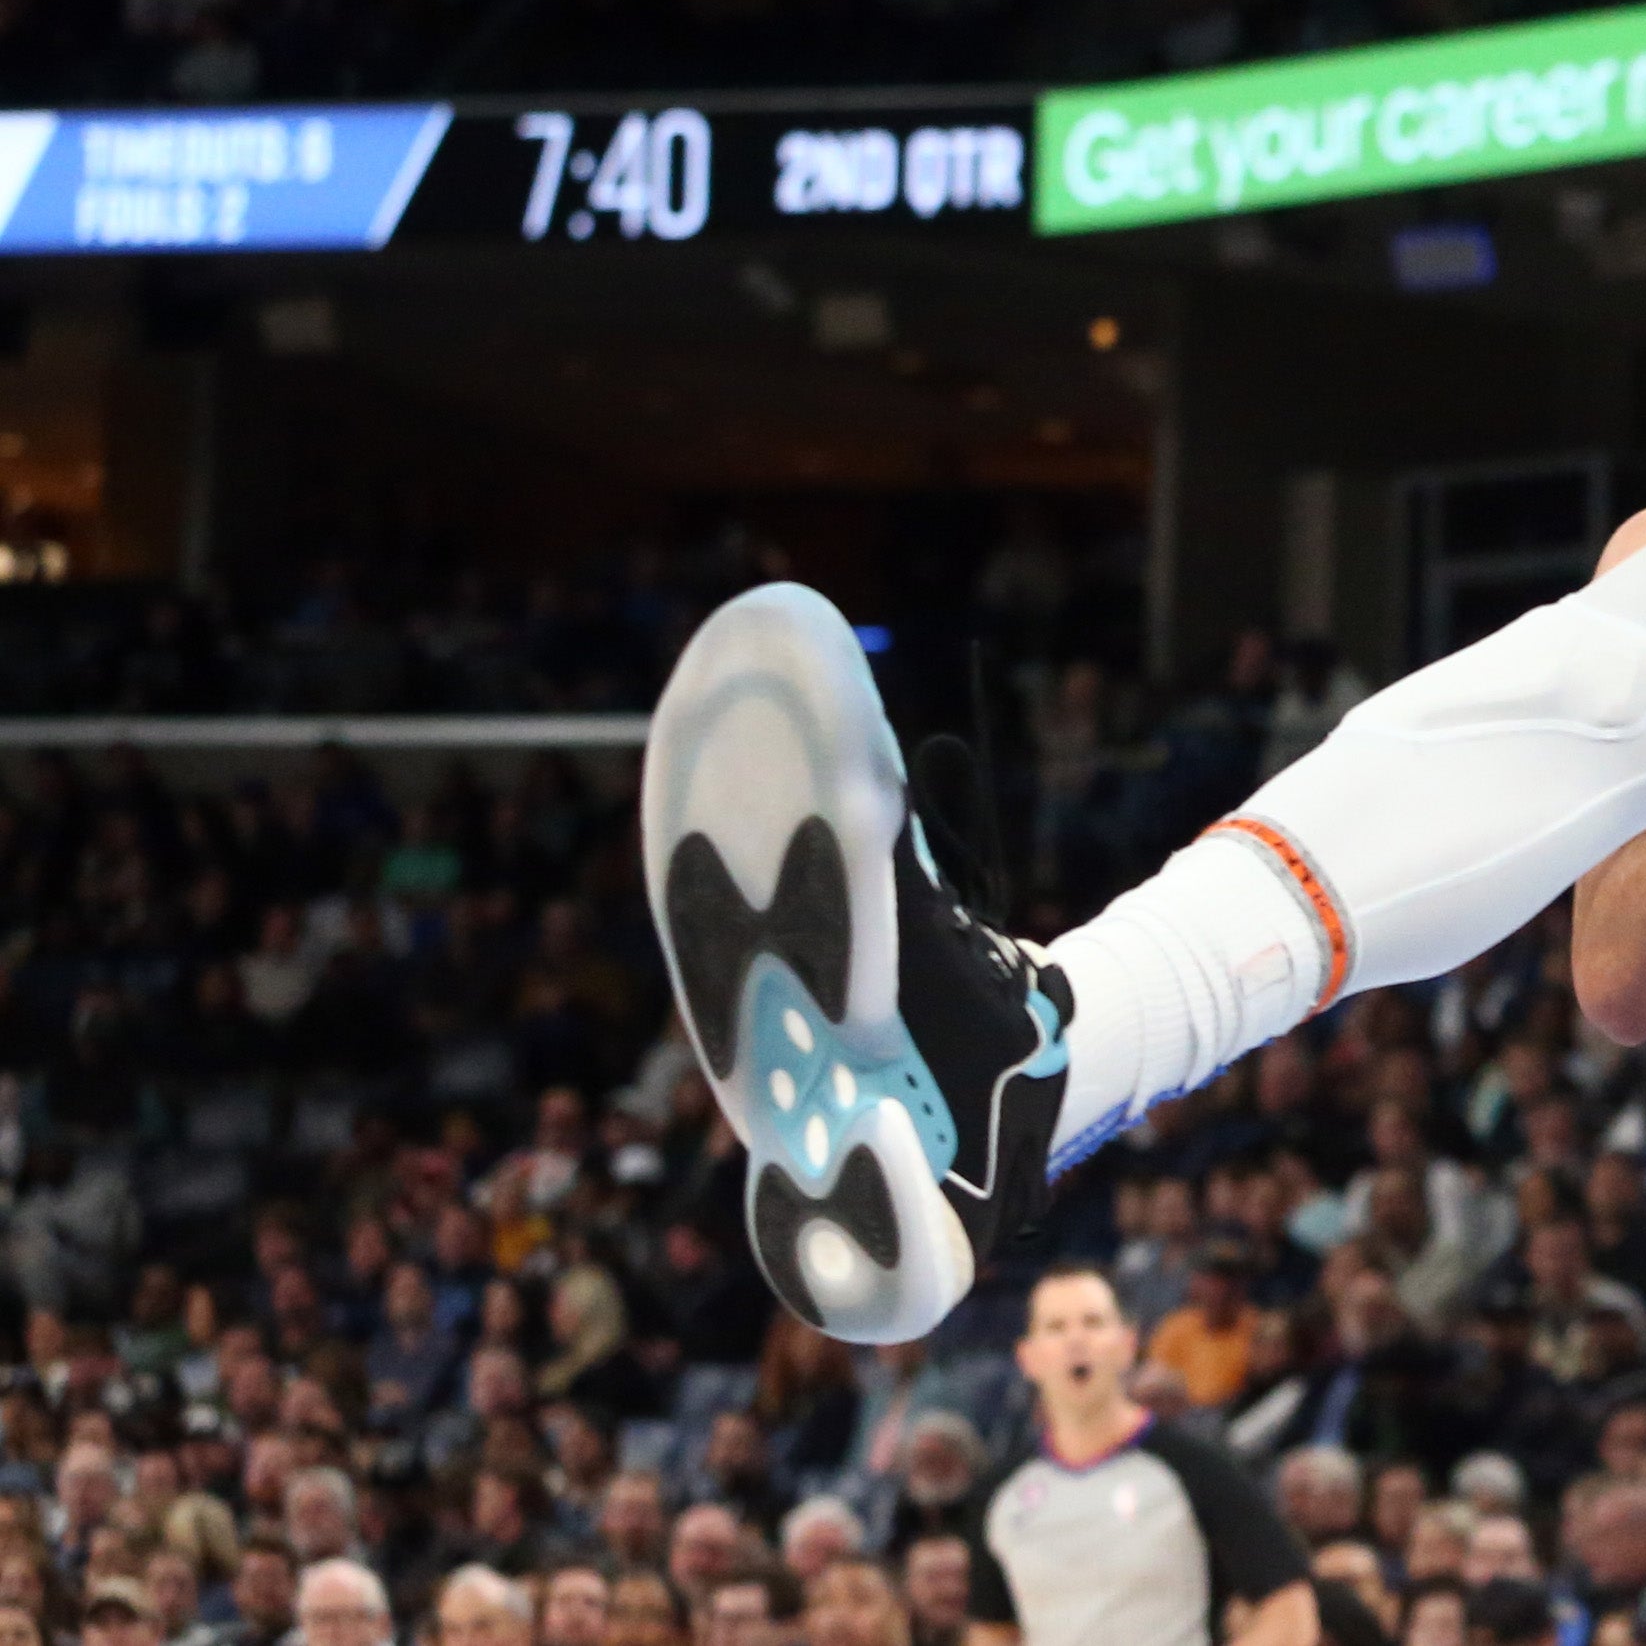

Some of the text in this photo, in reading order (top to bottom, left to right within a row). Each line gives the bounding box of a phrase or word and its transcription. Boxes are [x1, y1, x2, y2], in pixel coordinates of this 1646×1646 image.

[513, 107, 1025, 242] 7:40 2ND QTR
[1062, 108, 1201, 207] Get
[1207, 94, 1374, 212] your
[1375, 58, 1622, 166] career
